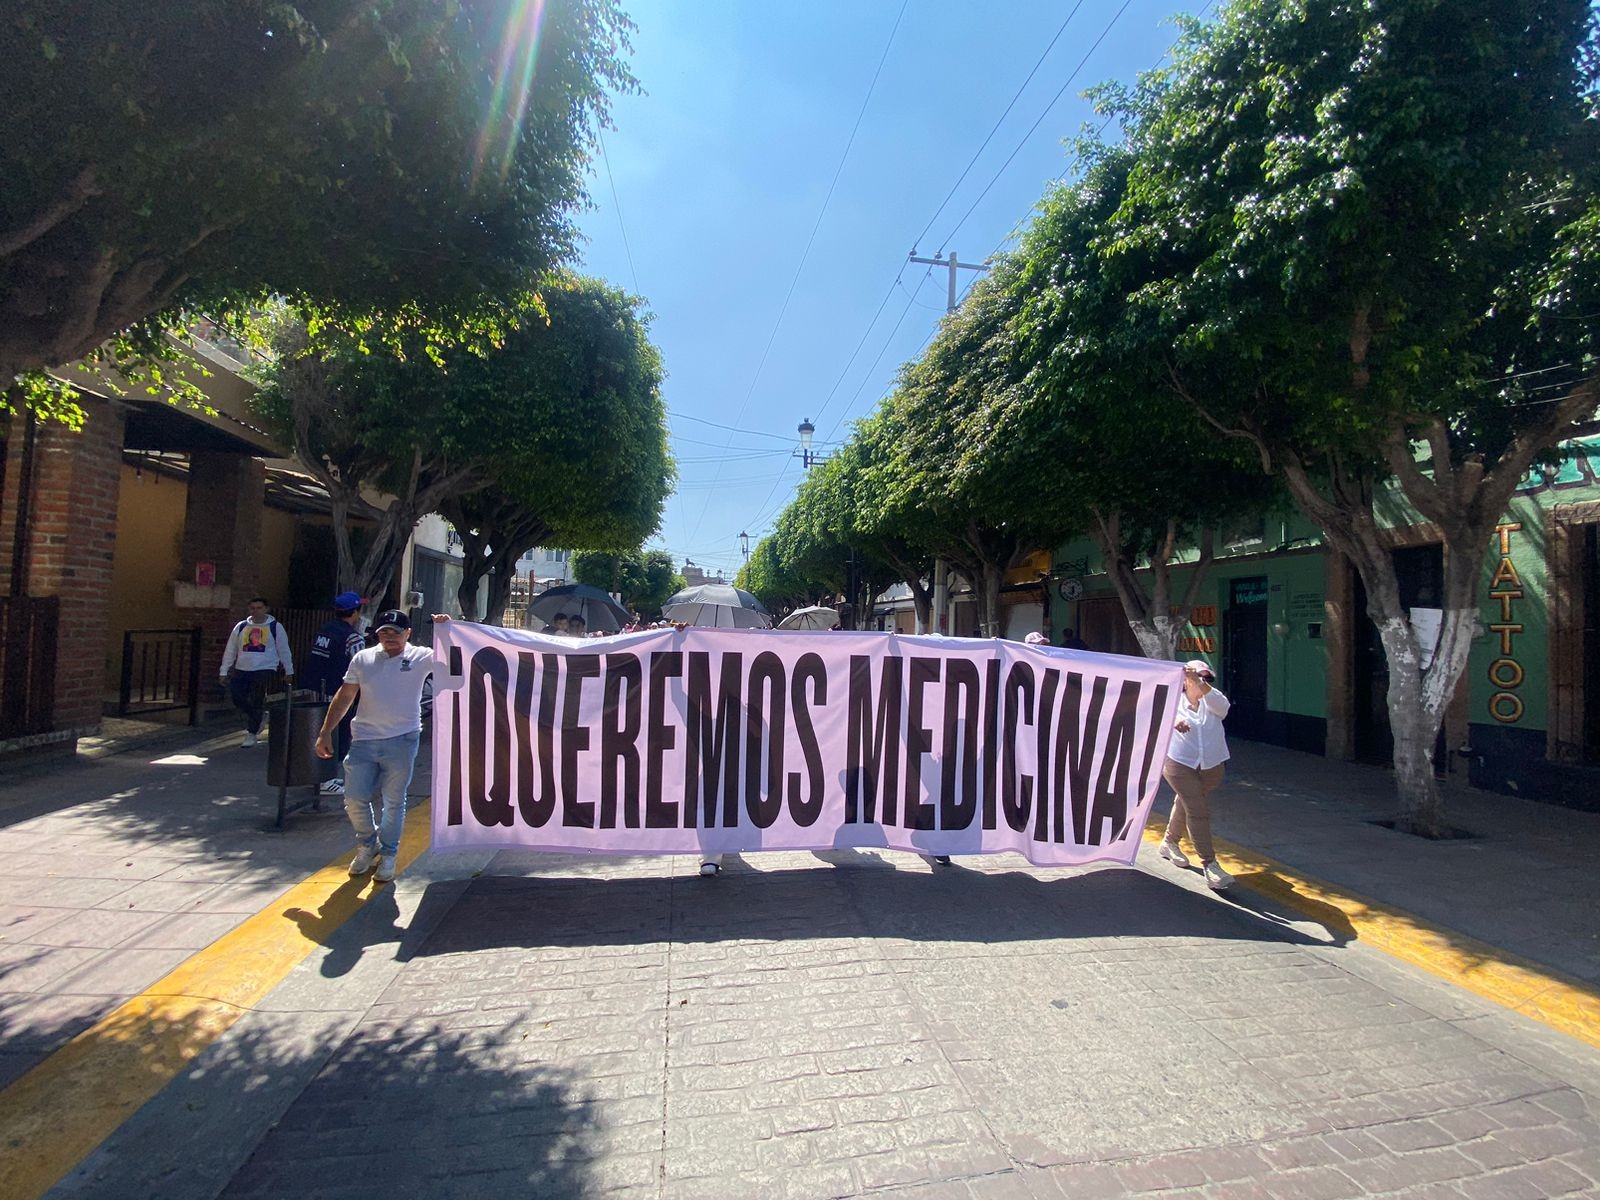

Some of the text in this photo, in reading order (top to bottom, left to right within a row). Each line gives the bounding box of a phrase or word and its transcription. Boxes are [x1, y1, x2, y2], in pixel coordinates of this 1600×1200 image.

[1488, 522, 1524, 723] TATTOO
[447, 646, 1169, 846] ¡QUEREMOS MEDICINA!
